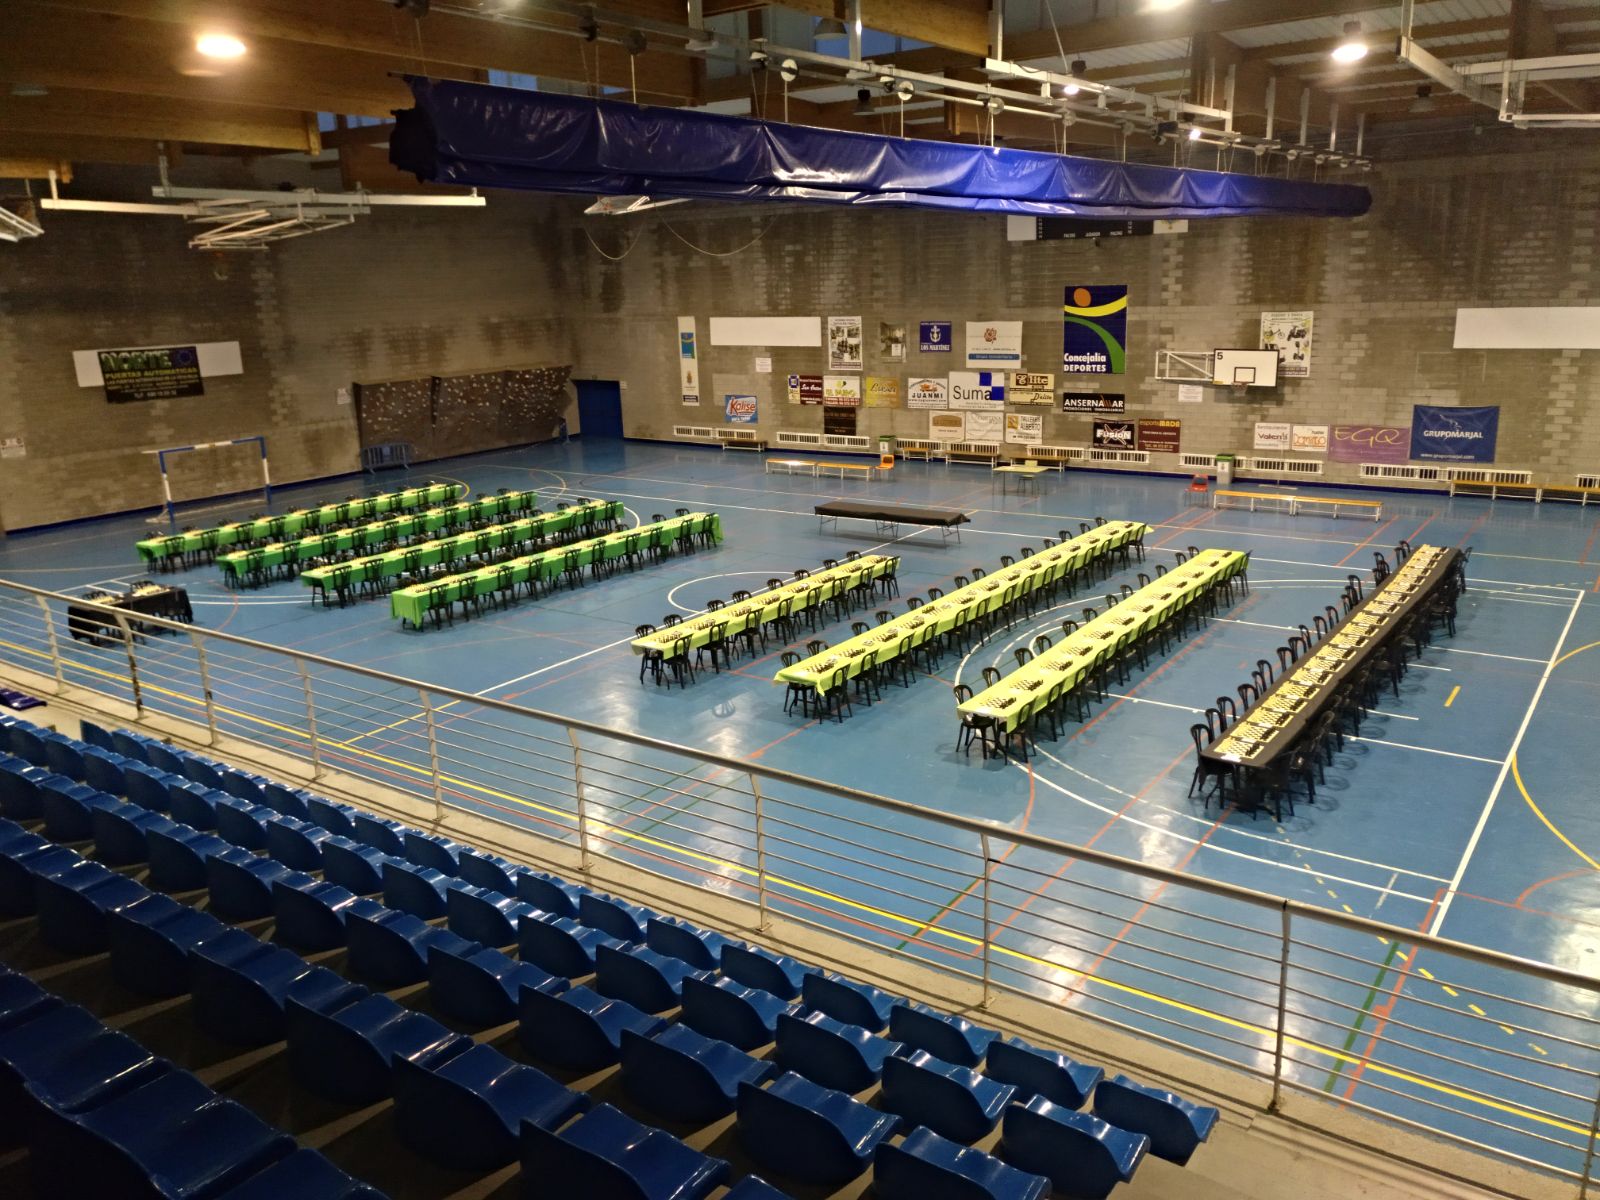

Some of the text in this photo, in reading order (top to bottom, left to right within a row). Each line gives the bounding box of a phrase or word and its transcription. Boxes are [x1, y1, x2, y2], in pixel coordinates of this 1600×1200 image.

[101, 350, 172, 371] NORTE
[1216, 351, 1224, 360] 5
[105, 367, 198, 380] PUERTAS AUTOMATICAS
[1063, 364, 1107, 372] DEPORTES
[953, 385, 992, 401] Suma
[730, 400, 756, 416] Kalise
[1020, 423, 1041, 431] ALBERTO
[1423, 430, 1484, 440] GRUPOMARJAL
